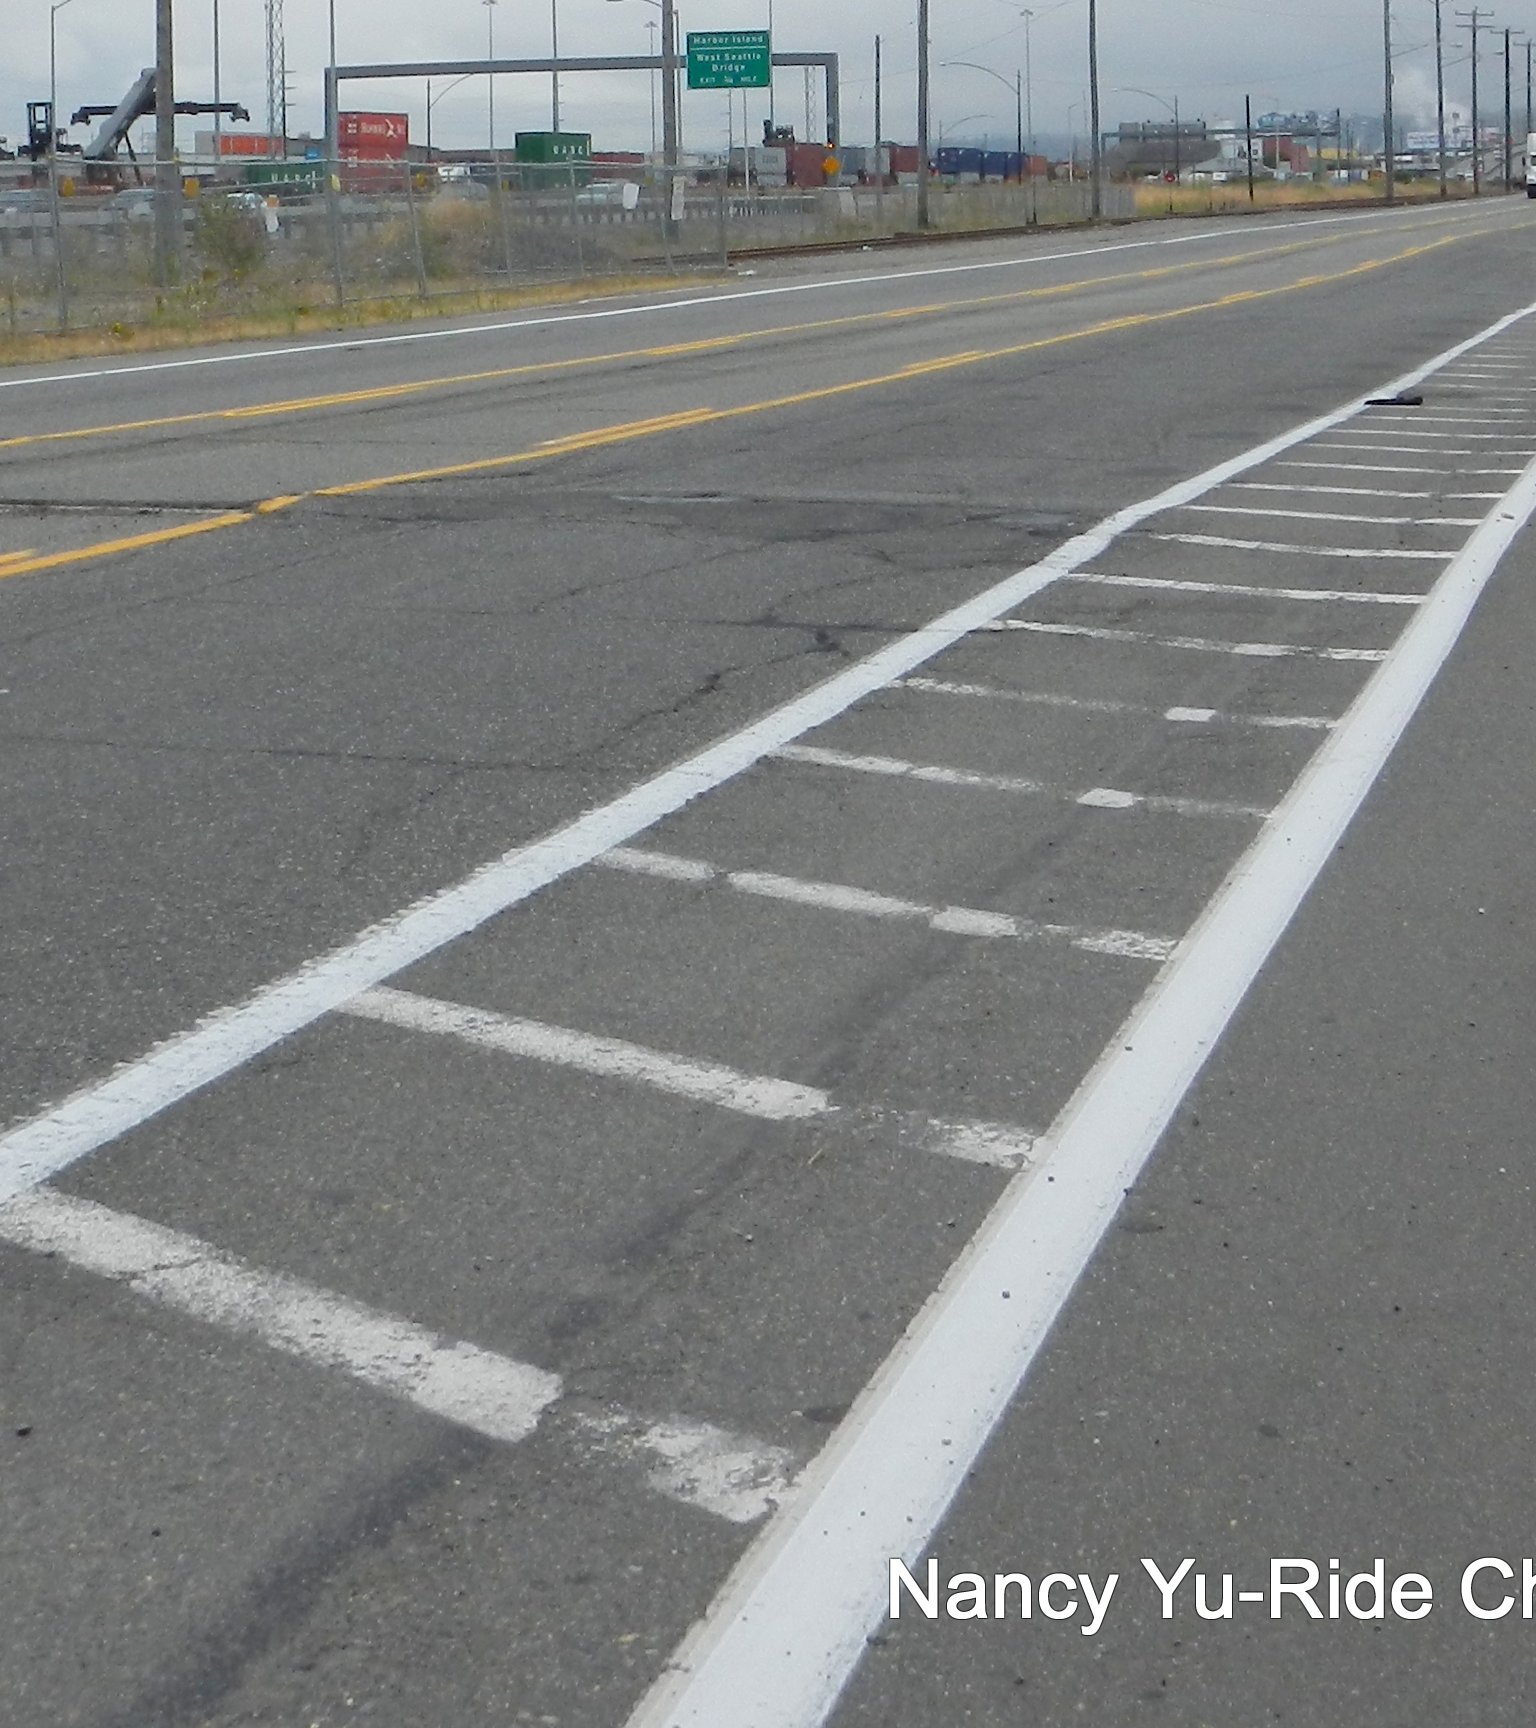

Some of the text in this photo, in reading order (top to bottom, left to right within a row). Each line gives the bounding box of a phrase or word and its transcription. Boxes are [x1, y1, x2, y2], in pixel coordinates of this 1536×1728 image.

[693, 35, 764, 44] Harbor Island
[696, 52, 761, 62] West Seattle
[711, 63, 746, 72] Bridge
